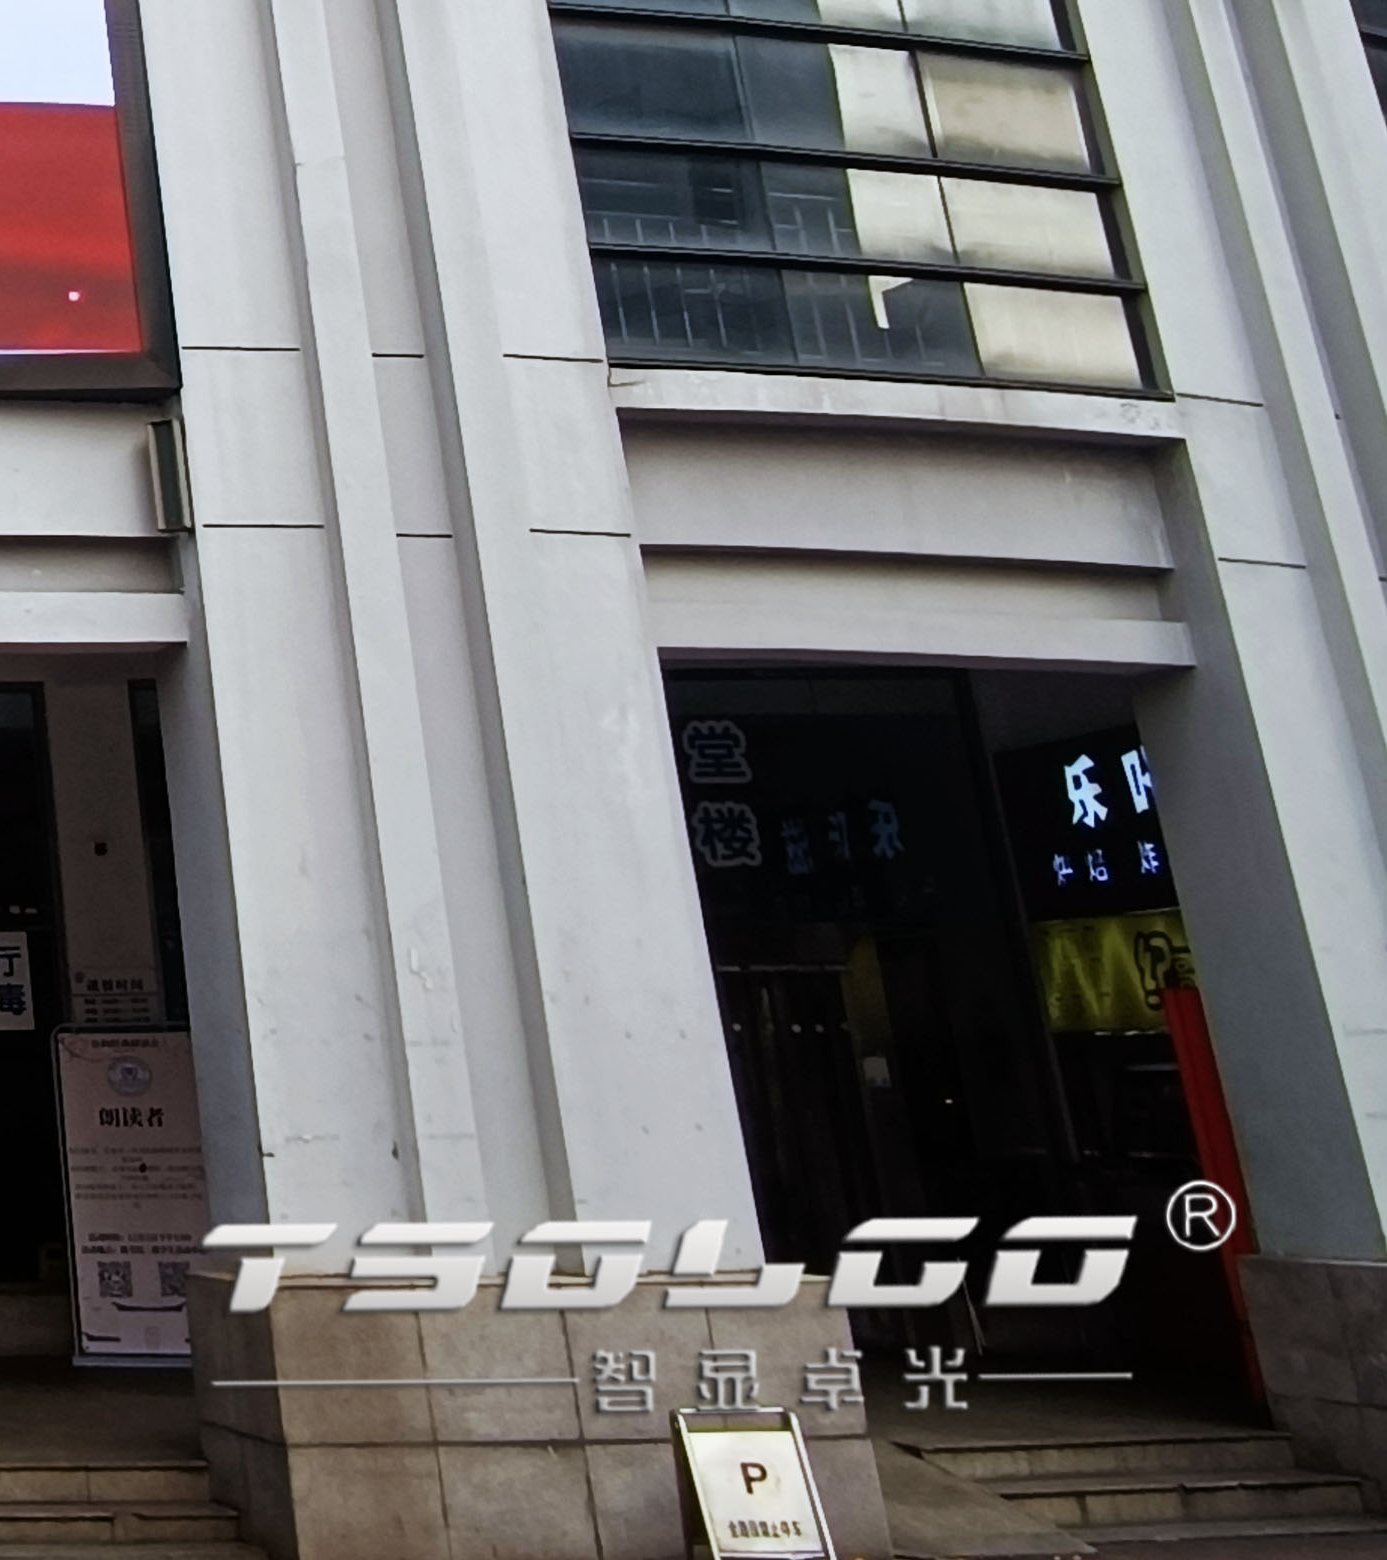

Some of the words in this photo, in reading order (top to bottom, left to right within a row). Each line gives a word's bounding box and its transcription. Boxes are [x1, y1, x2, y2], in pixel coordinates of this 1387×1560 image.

[683, 720, 752, 783] 堂
[692, 801, 763, 867] 楼
[99, 1106, 164, 1128] 朗读者
[740, 1462, 768, 1494] P
